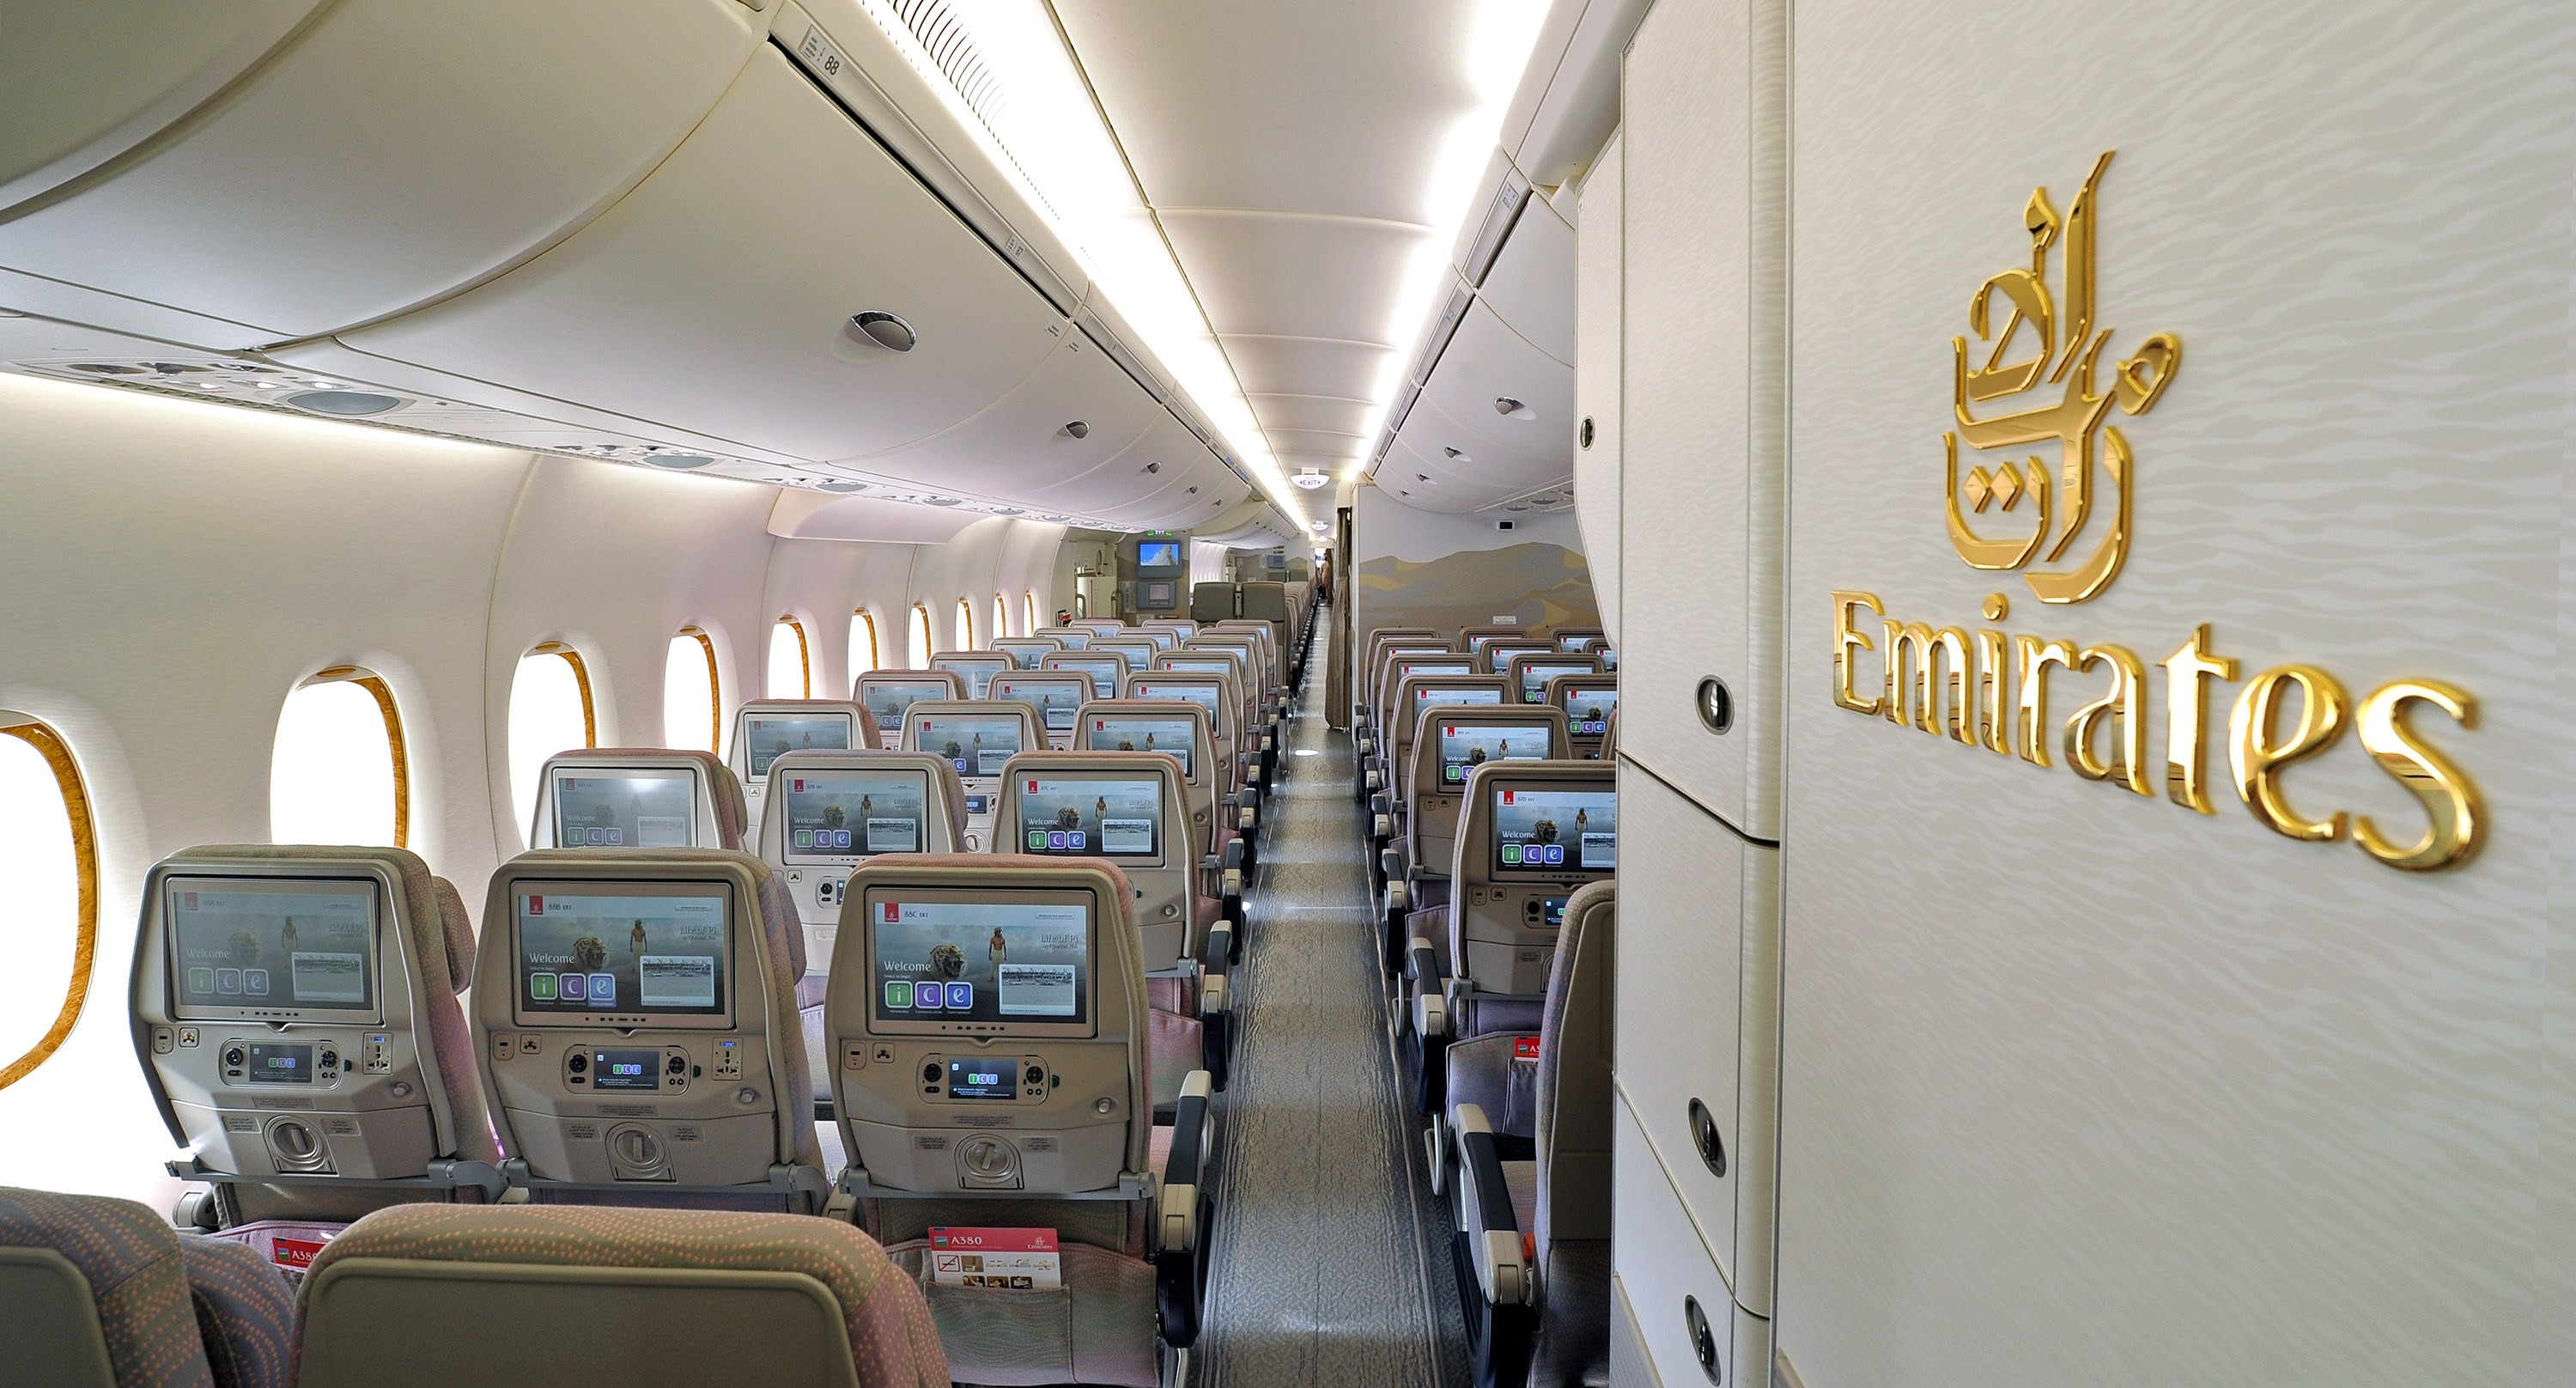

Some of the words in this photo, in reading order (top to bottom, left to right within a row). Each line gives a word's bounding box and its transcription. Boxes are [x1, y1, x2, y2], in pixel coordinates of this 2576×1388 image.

[824, 55, 840, 76] 88
[1832, 590, 2490, 872] Emirates
[1502, 831, 1535, 839] Welcome
[680, 926, 696, 934] Life
[696, 926, 705, 934] of
[1040, 934, 1056, 942] Life
[1058, 934, 1067, 942] of
[1069, 934, 1078, 942] Pi
[185, 947, 230, 959] Welcome
[529, 953, 574, 964] Welcome
[884, 961, 932, 972] Welcome
[951, 1236, 982, 1245] A380
